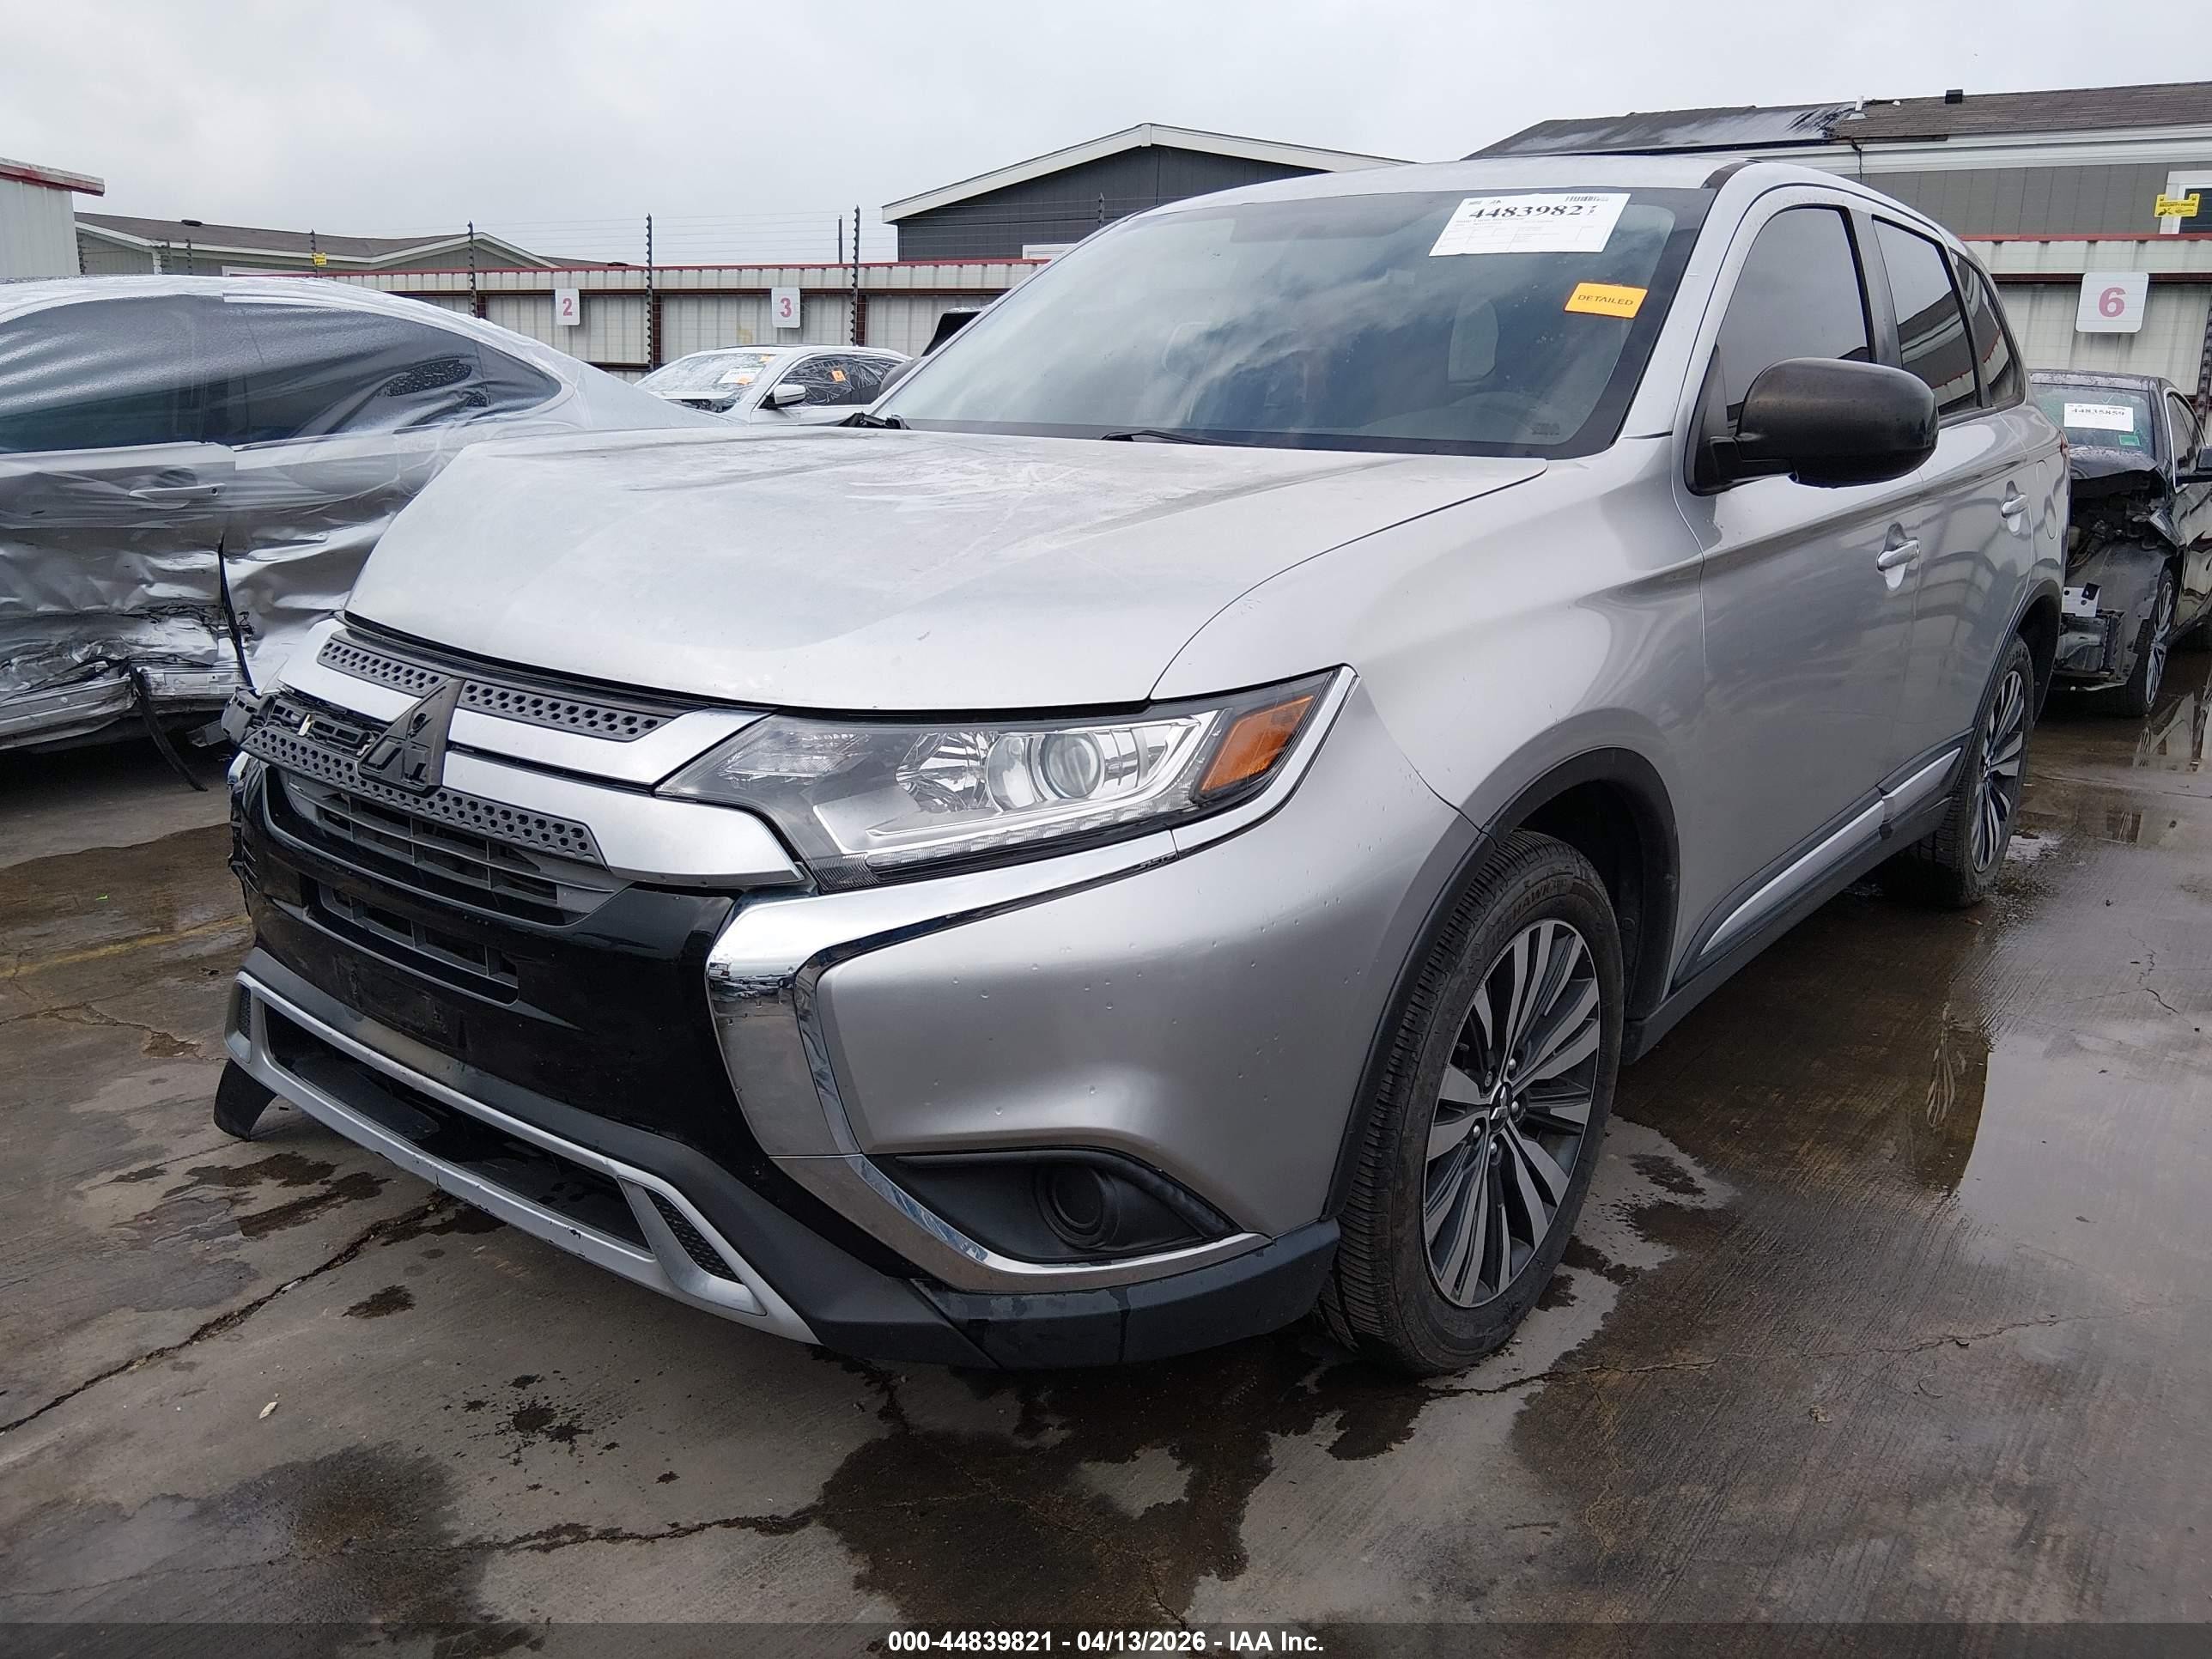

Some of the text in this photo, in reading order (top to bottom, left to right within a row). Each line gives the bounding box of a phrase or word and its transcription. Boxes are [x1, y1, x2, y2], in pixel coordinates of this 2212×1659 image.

[562, 298, 573, 316] 2
[780, 297, 792, 318] 3
[1577, 295, 1633, 307] DETAILED
[2099, 287, 2126, 318] 6
